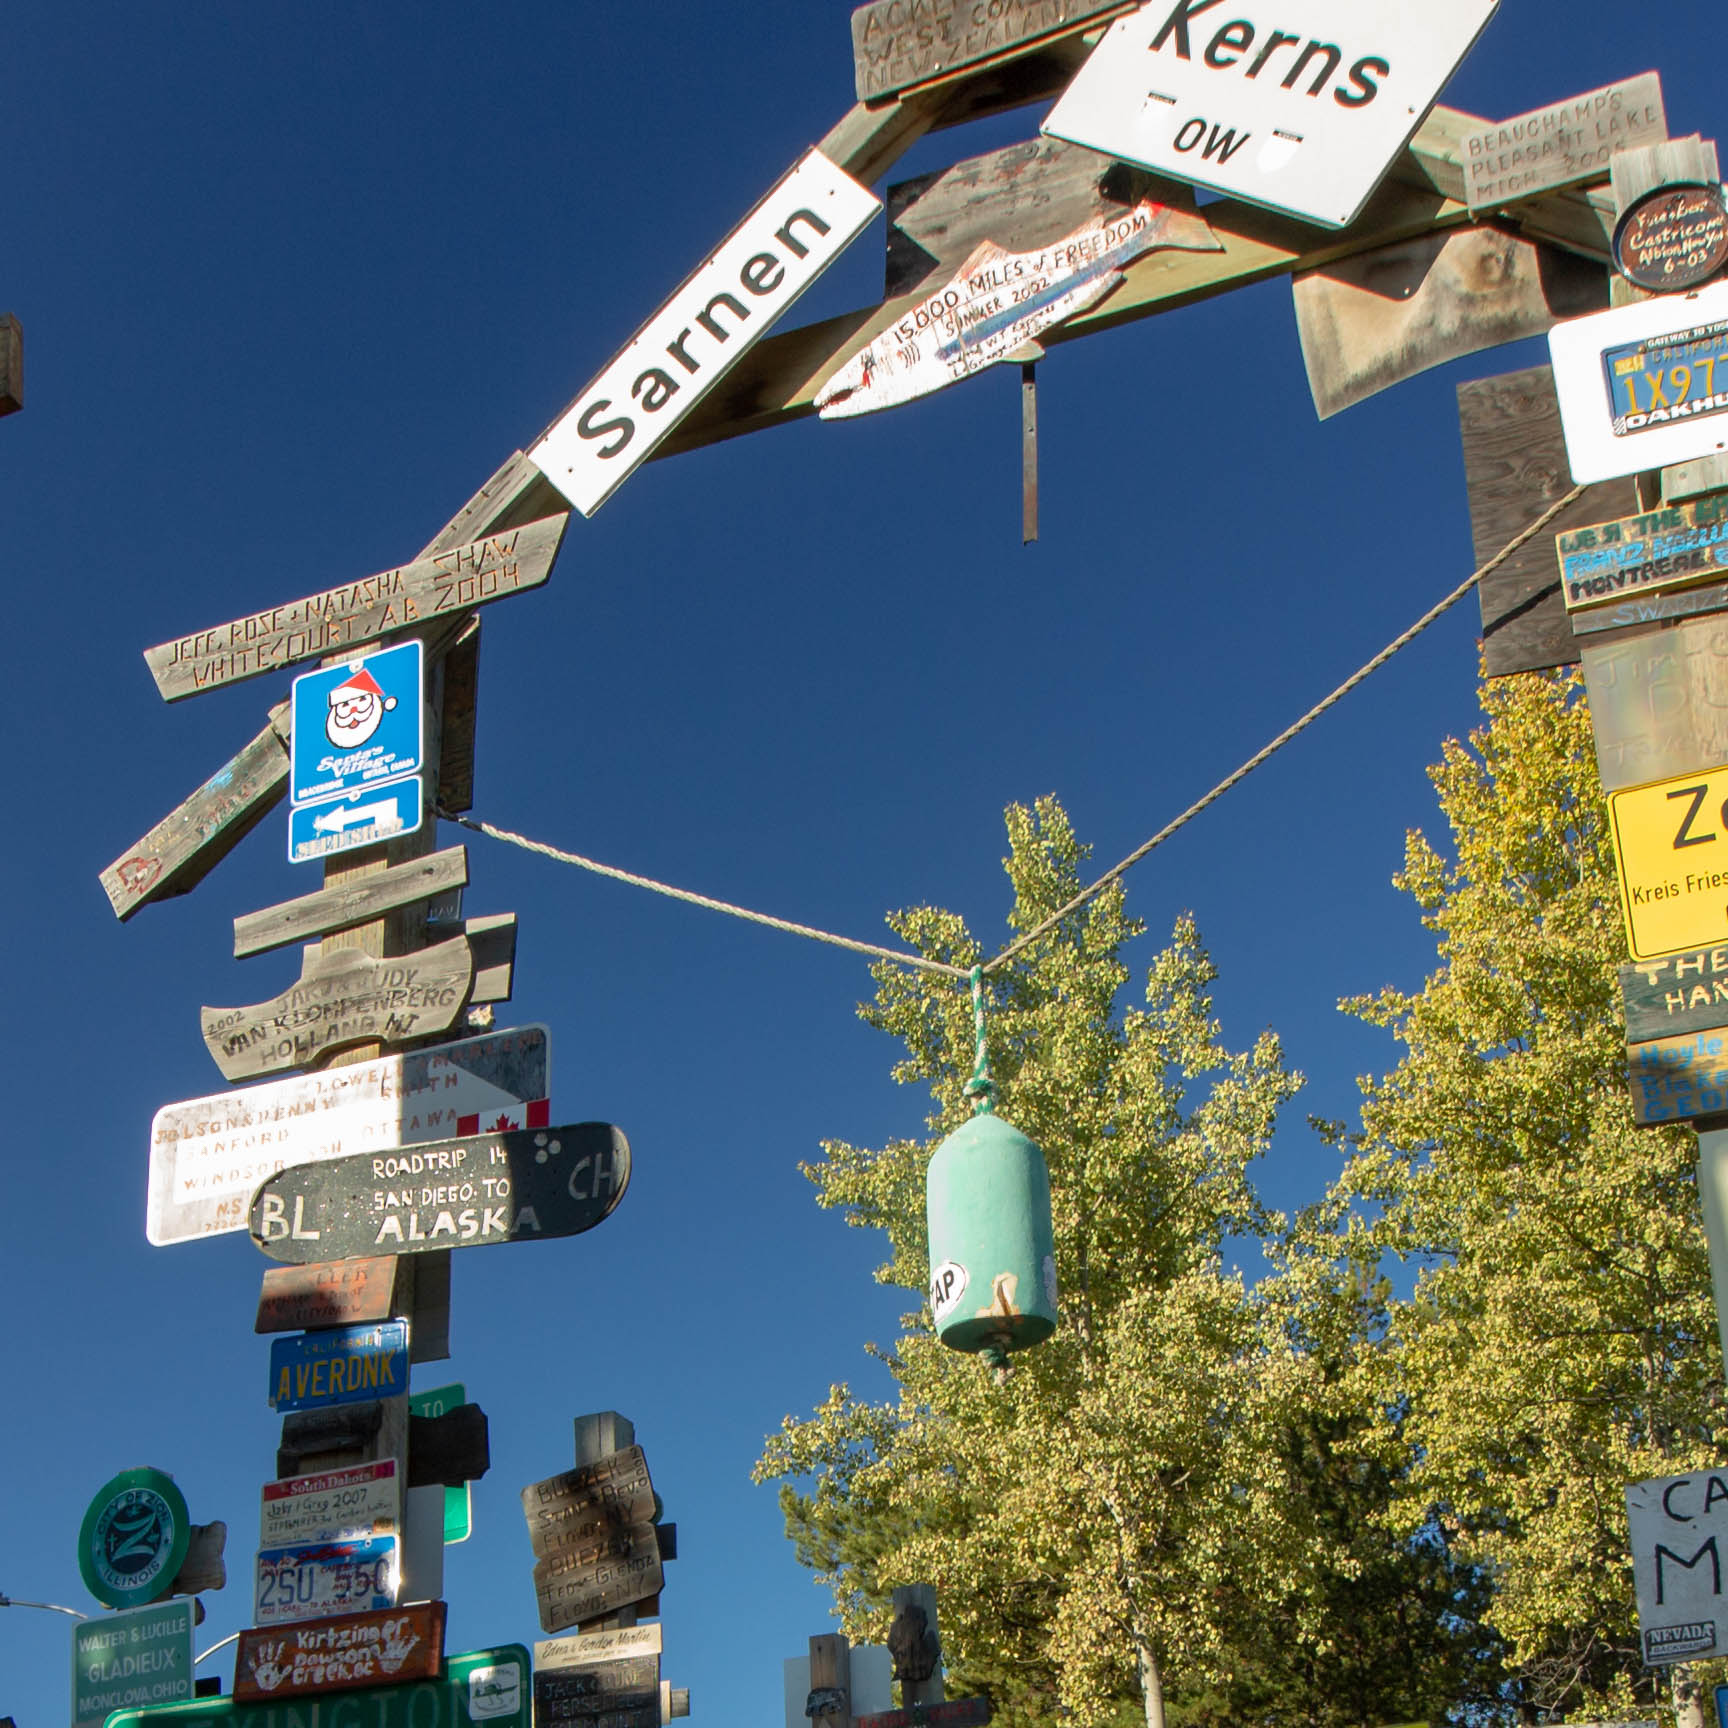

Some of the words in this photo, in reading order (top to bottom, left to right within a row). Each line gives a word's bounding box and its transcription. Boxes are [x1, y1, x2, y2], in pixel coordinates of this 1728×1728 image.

[1149, 0, 1390, 107] Kerns
[1172, 117, 1251, 165] OW
[576, 203, 832, 460] Sarnen
[1632, 879, 1681, 906] Kreis
[372, 1152, 466, 1181] ROADTRIP
[489, 1146, 508, 1165] 14
[374, 1187, 418, 1210] SAN
[482, 1176, 511, 1198] TO
[376, 1205, 542, 1244] ALASKA
[276, 1349, 396, 1402] AVERDNK
[86, 1649, 176, 1683] GLADIEUX
